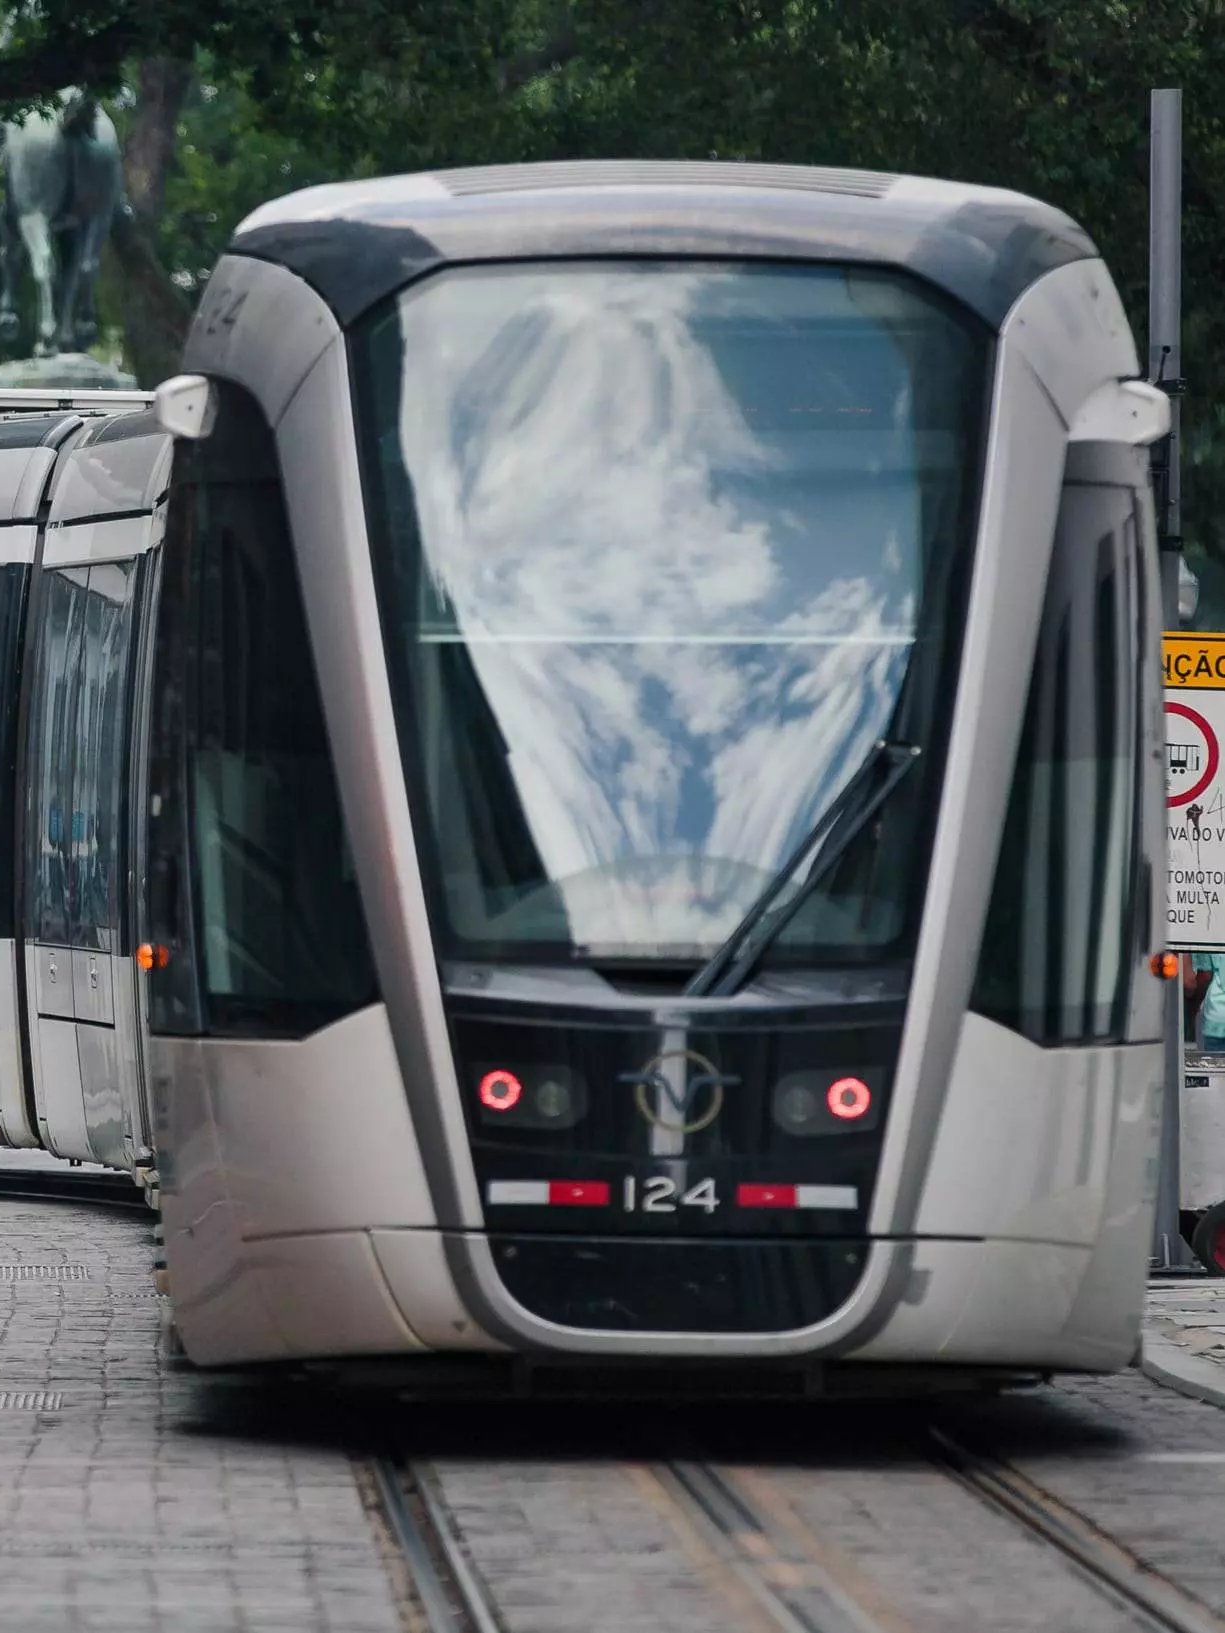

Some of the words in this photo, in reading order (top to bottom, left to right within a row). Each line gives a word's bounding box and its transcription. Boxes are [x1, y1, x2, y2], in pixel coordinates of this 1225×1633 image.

[1167, 870, 1225, 885] TOMOTO
[1177, 890, 1220, 905] MULTA
[623, 1175, 721, 1214] 124
